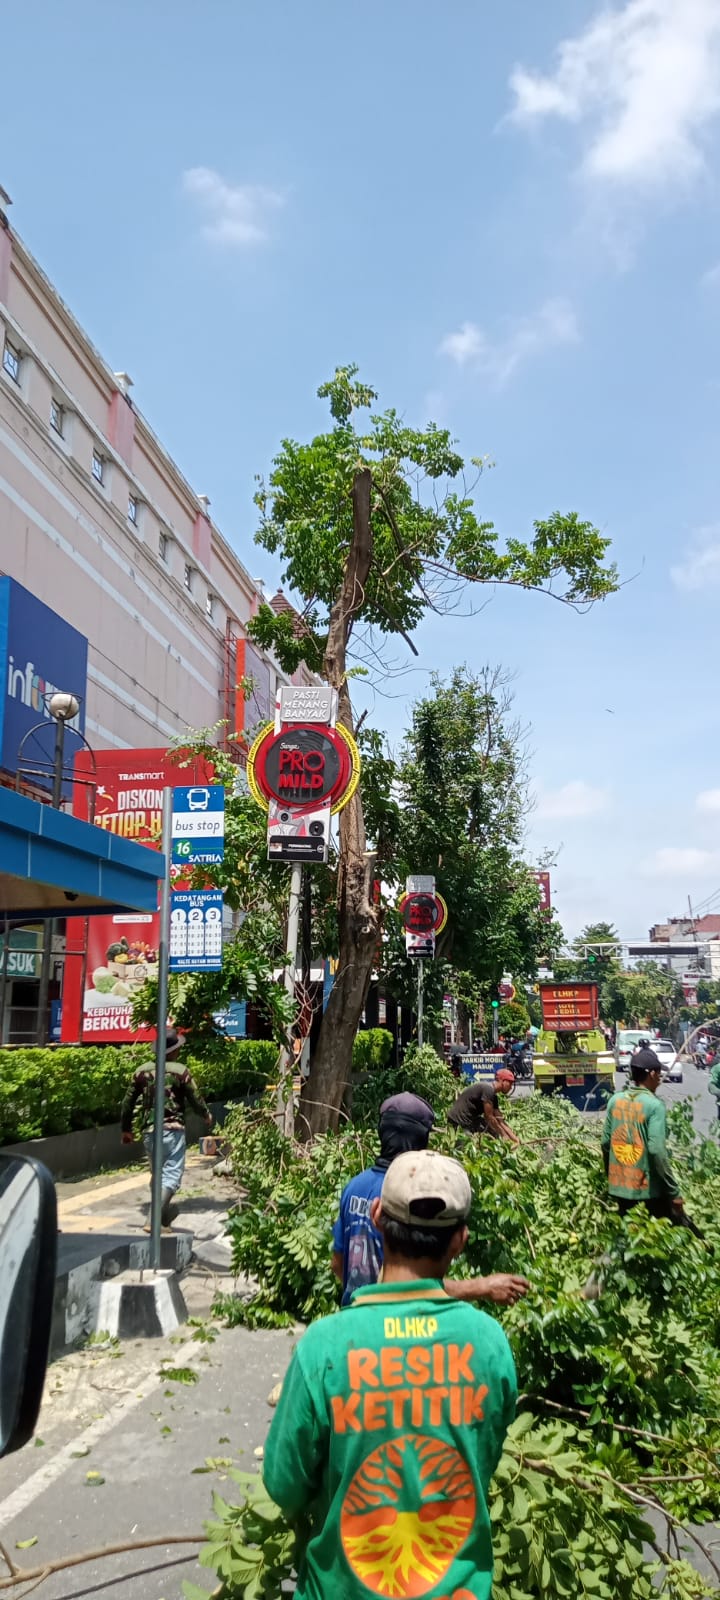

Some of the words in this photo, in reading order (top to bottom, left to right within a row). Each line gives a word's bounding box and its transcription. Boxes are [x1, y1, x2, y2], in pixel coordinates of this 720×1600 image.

[293, 692, 320, 700] PASTI
[284, 701, 329, 709] MENANG
[285, 709, 327, 719] BANYAK
[279, 751, 326, 771] PRO
[118, 772, 164, 780] TRANSmart
[279, 774, 324, 789] MILD
[118, 789, 164, 810] DISKON
[176, 820, 194, 831] bus
[197, 822, 220, 834] stop
[177, 842, 190, 855] 16
[188, 854, 222, 862] SATRIA
[174, 894, 222, 902] KEDATANGAN
[177, 912, 181, 921] 1
[192, 911, 199, 920] 2
[210, 910, 217, 920] 3
[87, 1006, 134, 1016] KEBUTUHA
[383, 1317, 438, 1339] DLHKP
[347, 1342, 475, 1390] RESIK
[330, 1385, 489, 1433] KETITIK
